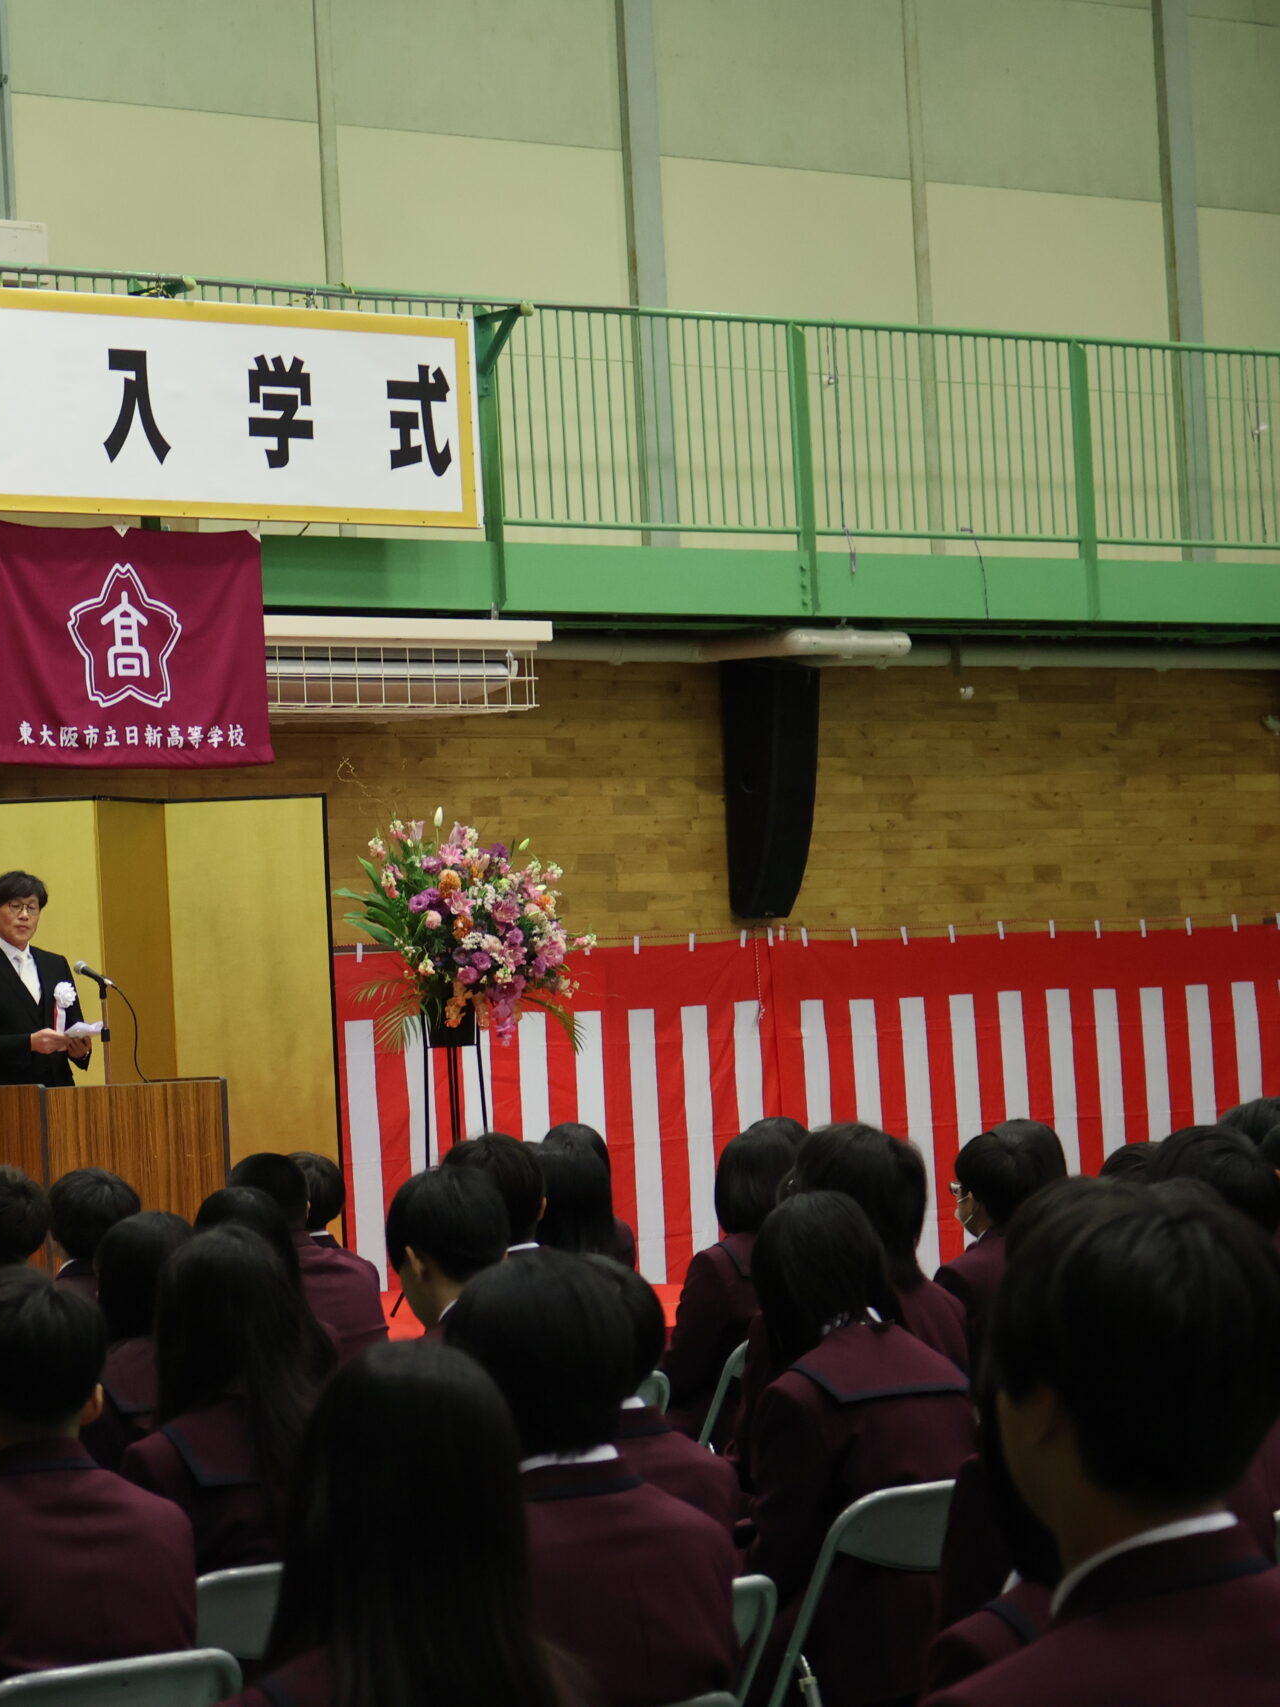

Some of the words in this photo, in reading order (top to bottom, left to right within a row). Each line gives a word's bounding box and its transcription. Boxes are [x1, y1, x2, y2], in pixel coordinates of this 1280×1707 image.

[104, 349, 451, 476] 入学式
[18, 721, 246, 749] 東大阪市立日新高等学校
